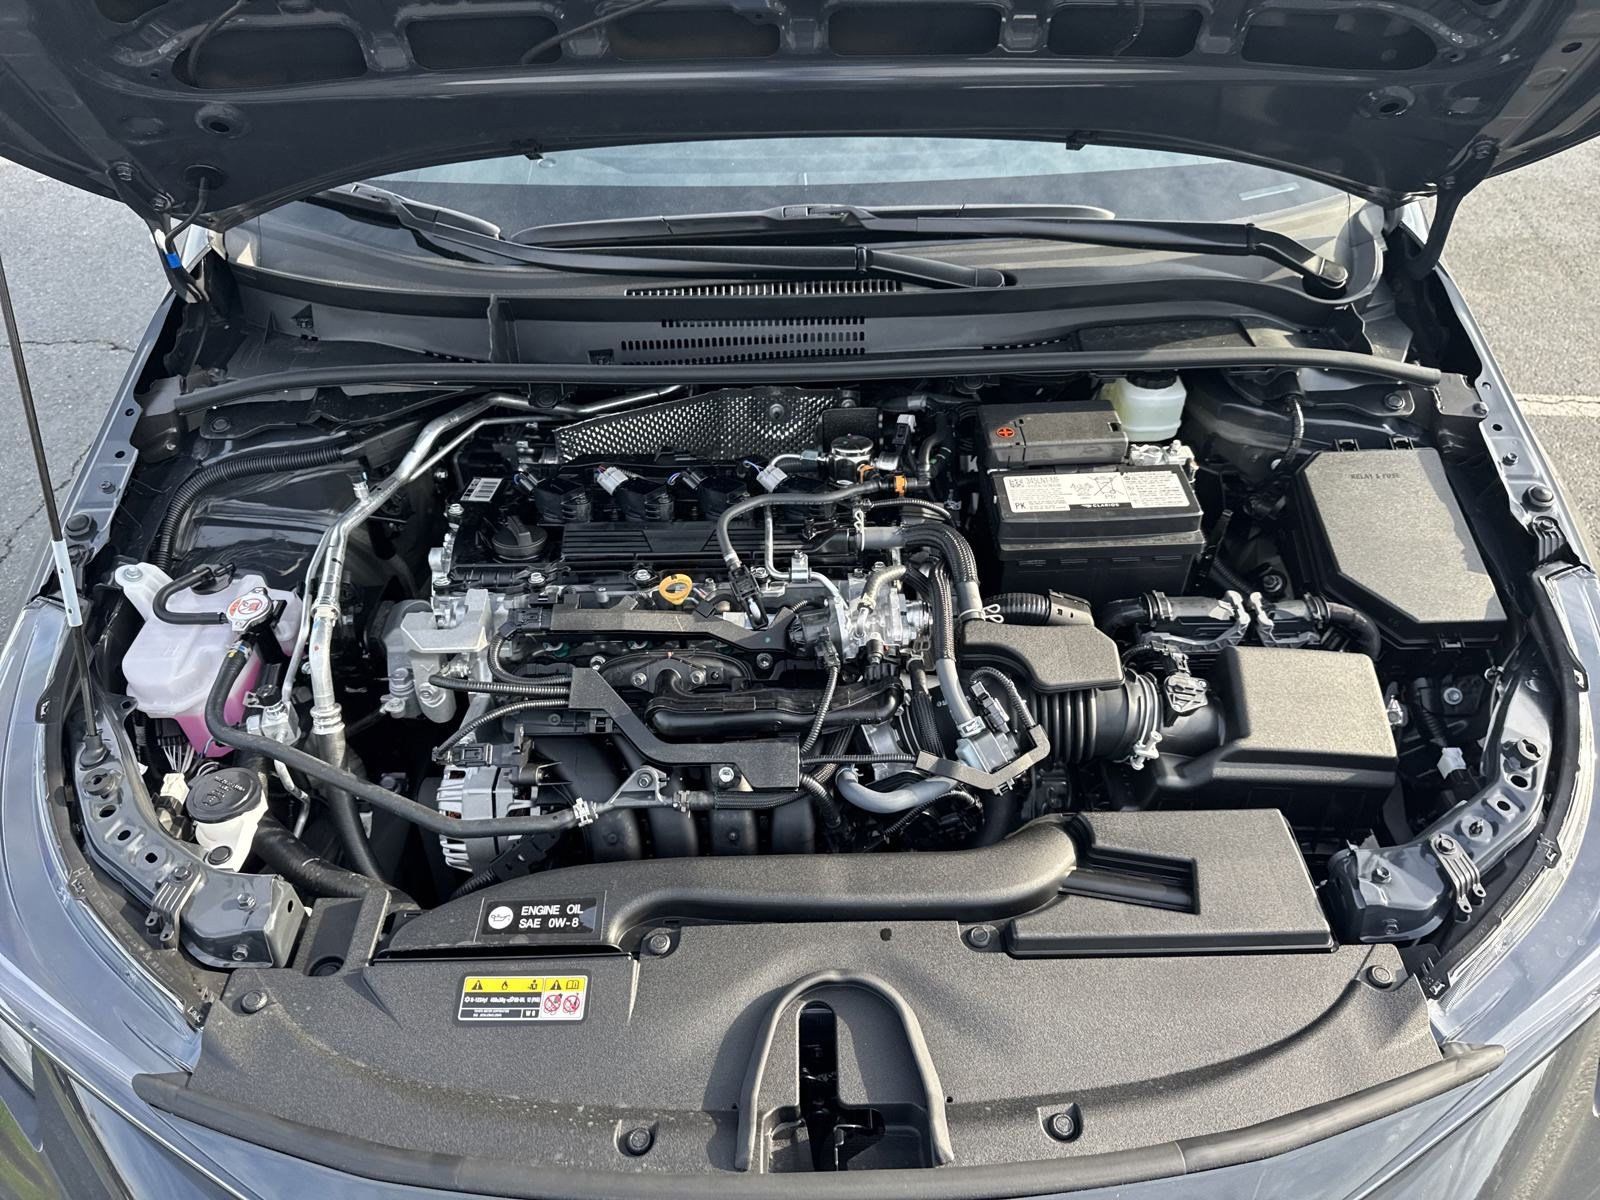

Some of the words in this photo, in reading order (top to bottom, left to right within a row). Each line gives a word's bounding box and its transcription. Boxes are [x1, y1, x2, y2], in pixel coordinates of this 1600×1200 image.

[521, 904, 561, 916] ENGINE
[566, 903, 584, 915] OIL
[518, 917, 542, 929] SAE
[548, 916, 579, 929] 0W-8
